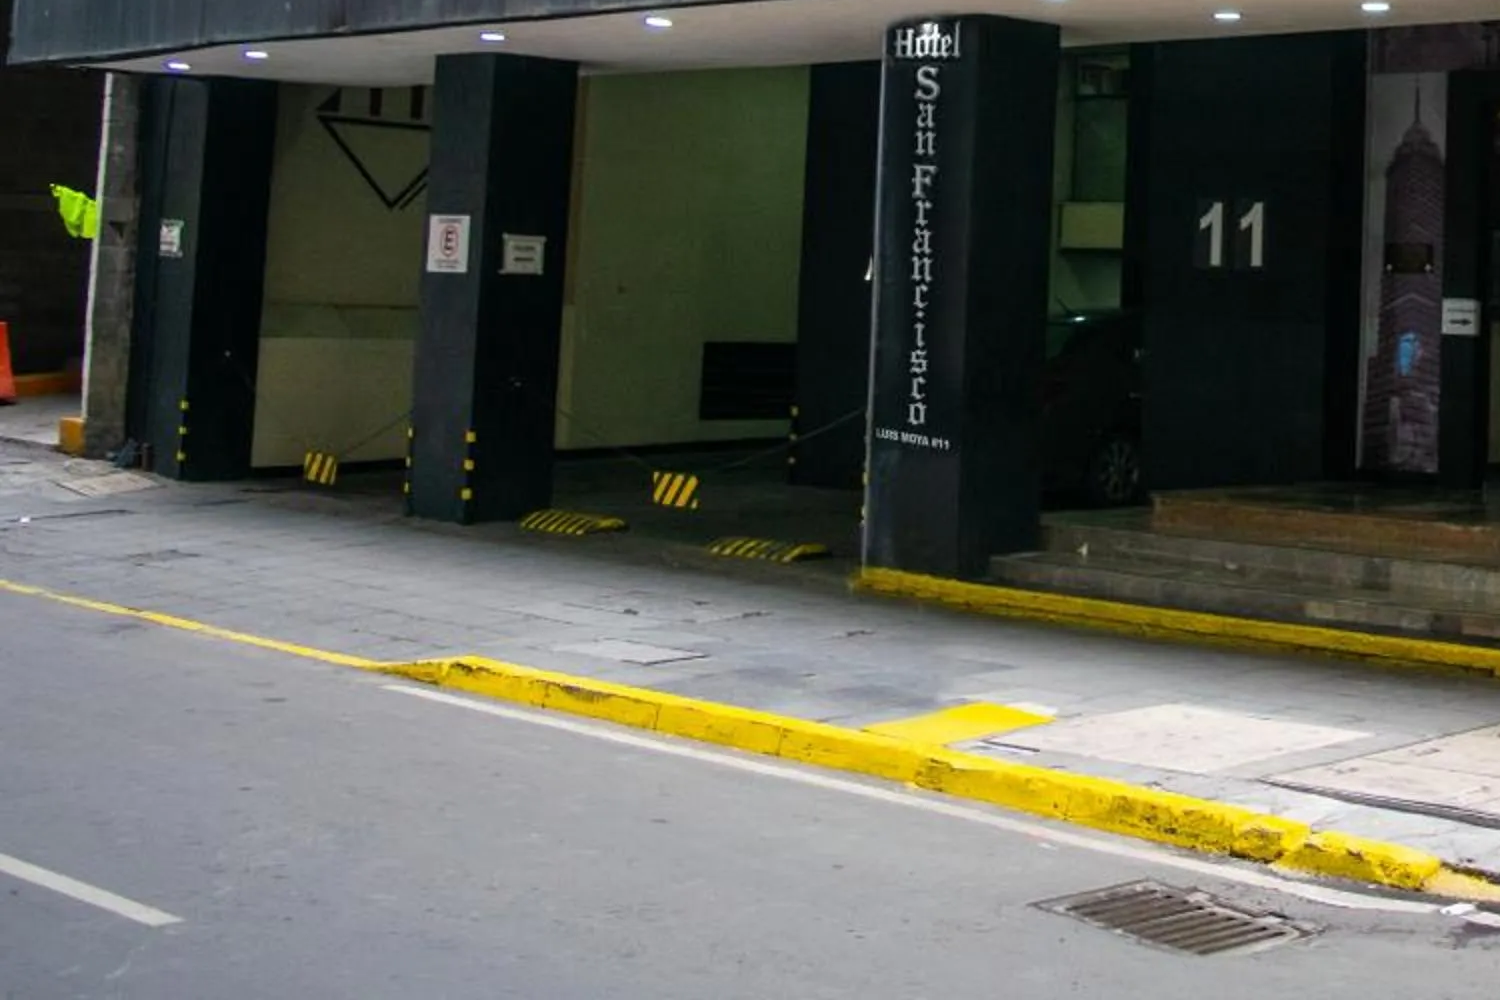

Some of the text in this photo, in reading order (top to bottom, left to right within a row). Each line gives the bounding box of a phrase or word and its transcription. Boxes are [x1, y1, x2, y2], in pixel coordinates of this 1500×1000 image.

[893, 20, 961, 59] Hotel
[913, 65, 941, 156] San
[1199, 201, 1265, 268] 11
